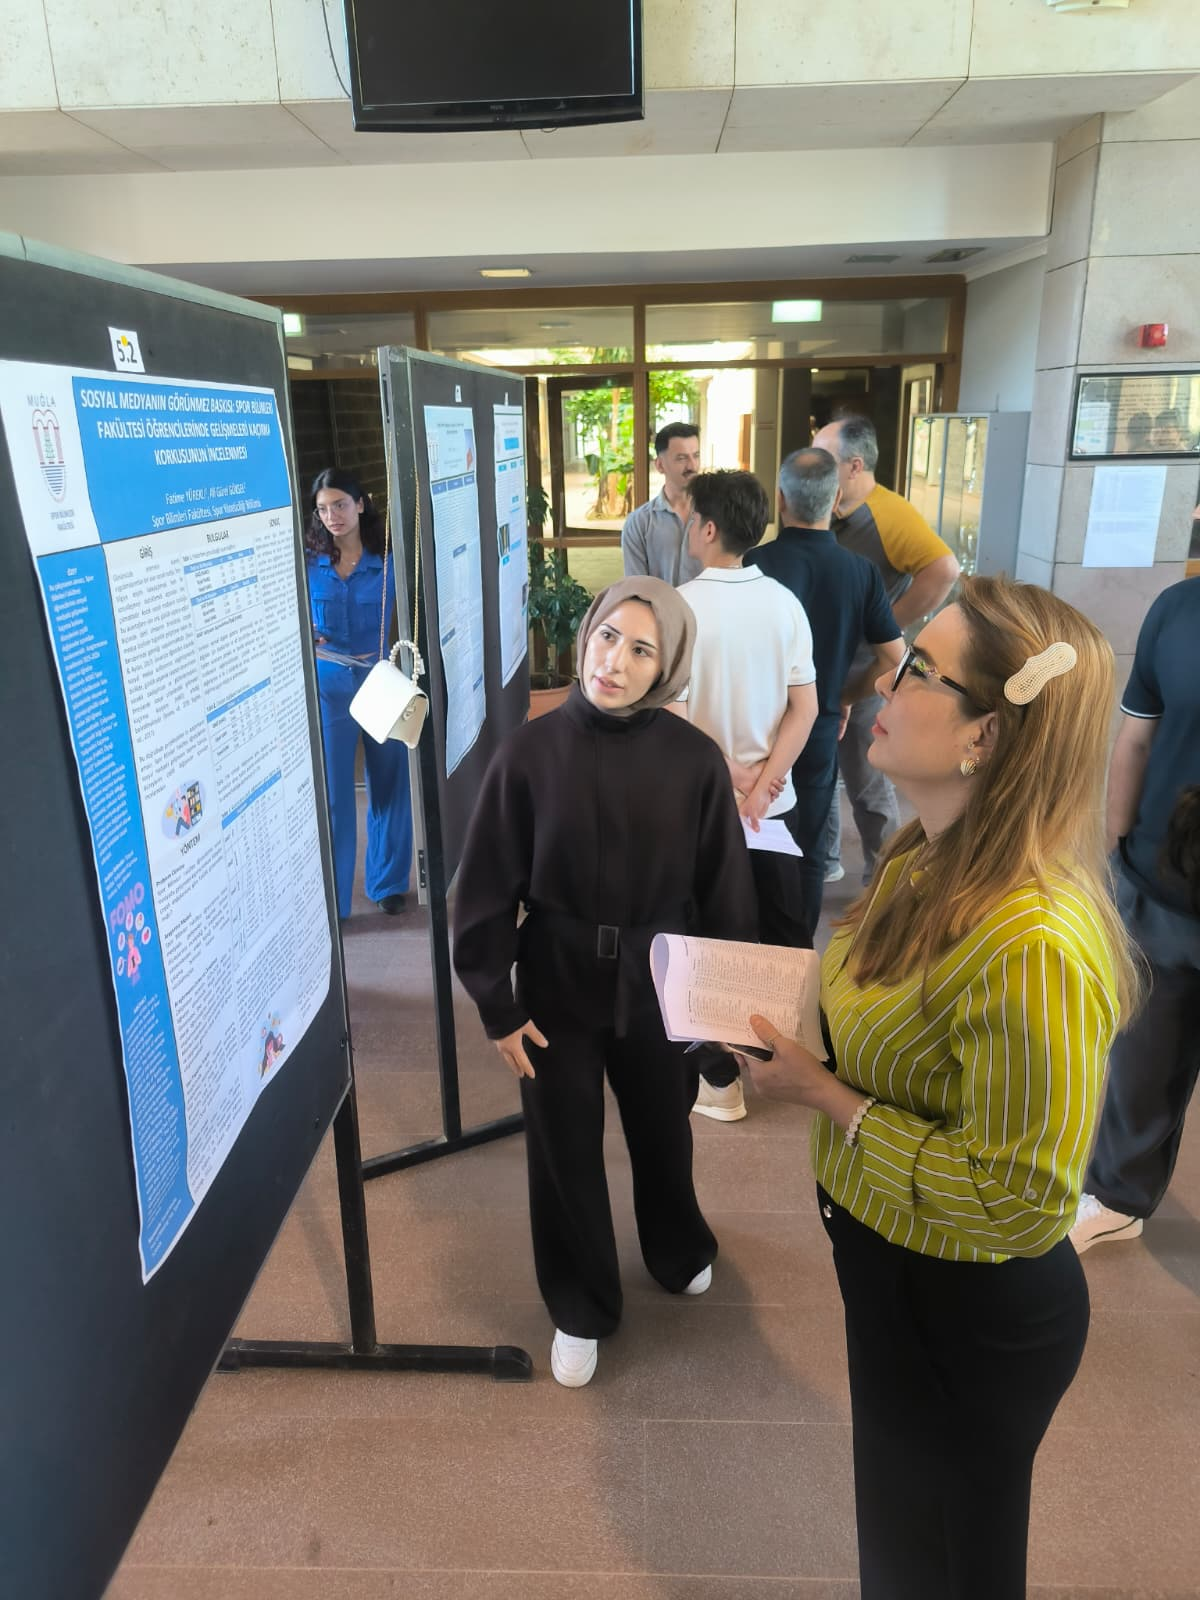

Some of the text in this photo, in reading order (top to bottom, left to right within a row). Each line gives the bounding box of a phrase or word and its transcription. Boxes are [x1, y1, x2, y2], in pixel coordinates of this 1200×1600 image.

[26, 392, 57, 407] MUĞLA
[80, 389, 118, 409] SOSYAL
[119, 391, 166, 411] MEDYANIN
[167, 392, 210, 412] GÖRÜNMEZ
[235, 399, 251, 413] SPOR
[96, 416, 146, 439] FAKÜLTESİ
[146, 417, 210, 439] ÖĞRENCİLERİNDE
[210, 420, 249, 440] GELİŞMELERİ
[154, 443, 248, 466] KORKUSUNUN İNCELENMESİ
[151, 513, 165, 528] Spor
[165, 511, 187, 525] Bilimleri
[212, 504, 224, 518] Spor
[206, 530, 229, 544] BULGULAR
[180, 832, 201, 857] YÖNTEM
[110, 882, 145, 935] FOMO
